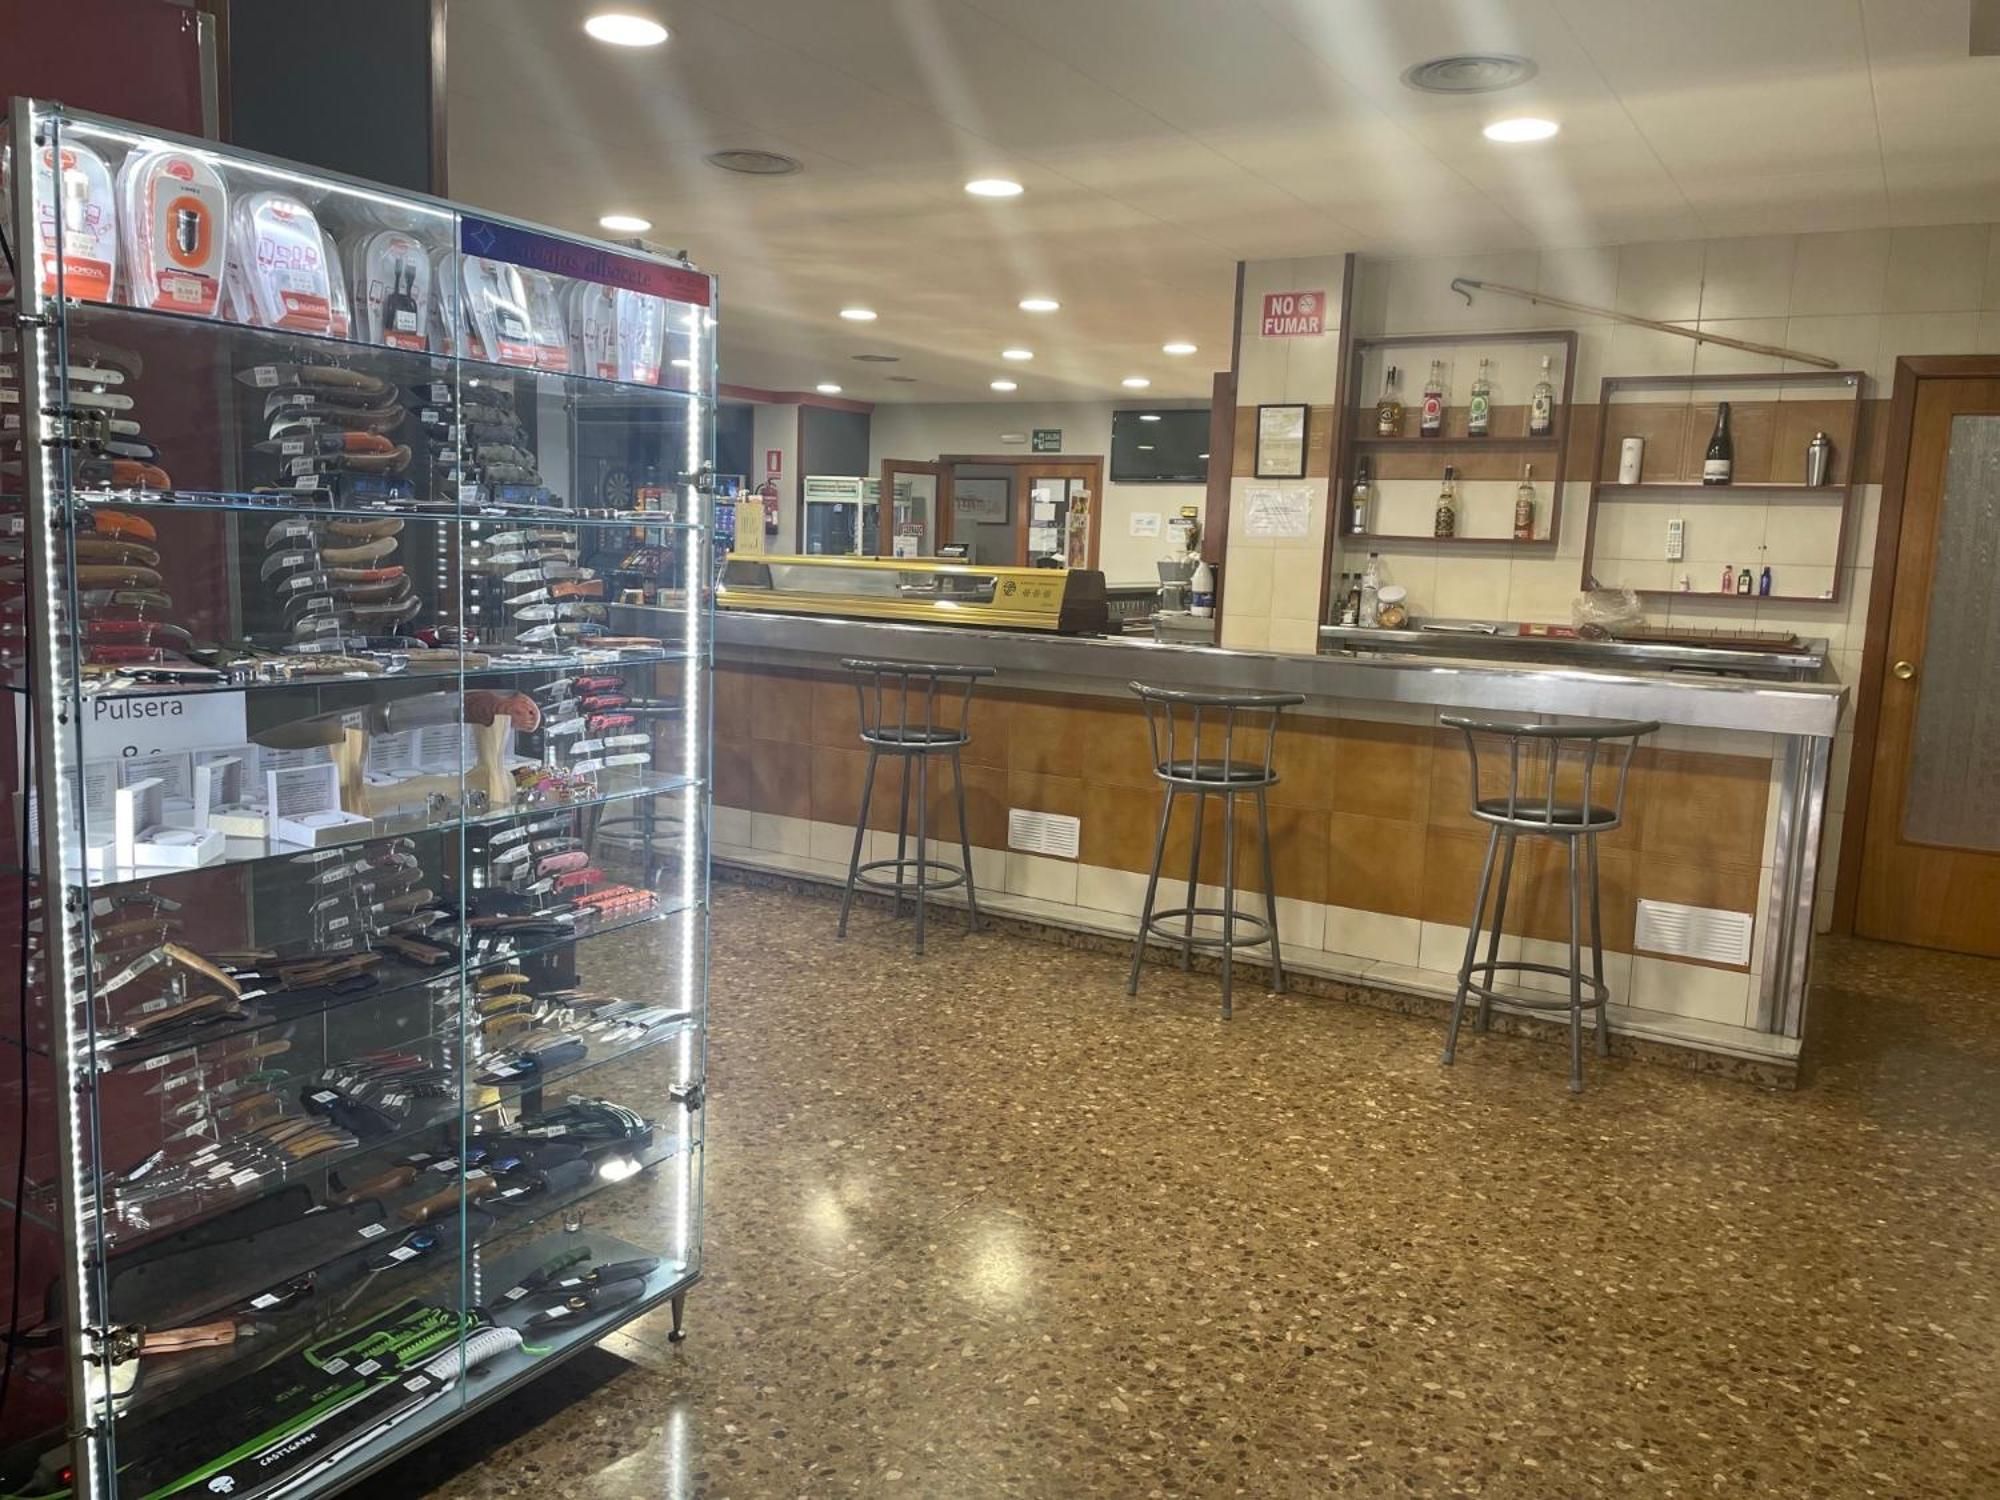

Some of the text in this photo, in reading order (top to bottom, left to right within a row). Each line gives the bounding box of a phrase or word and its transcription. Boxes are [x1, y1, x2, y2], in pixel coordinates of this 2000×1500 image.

[1271, 296, 1294, 316] NO
[1264, 316, 1319, 334] FUMAR
[94, 698, 183, 721] Pulsera
[260, 1432, 318, 1467] CASTIGADOR
